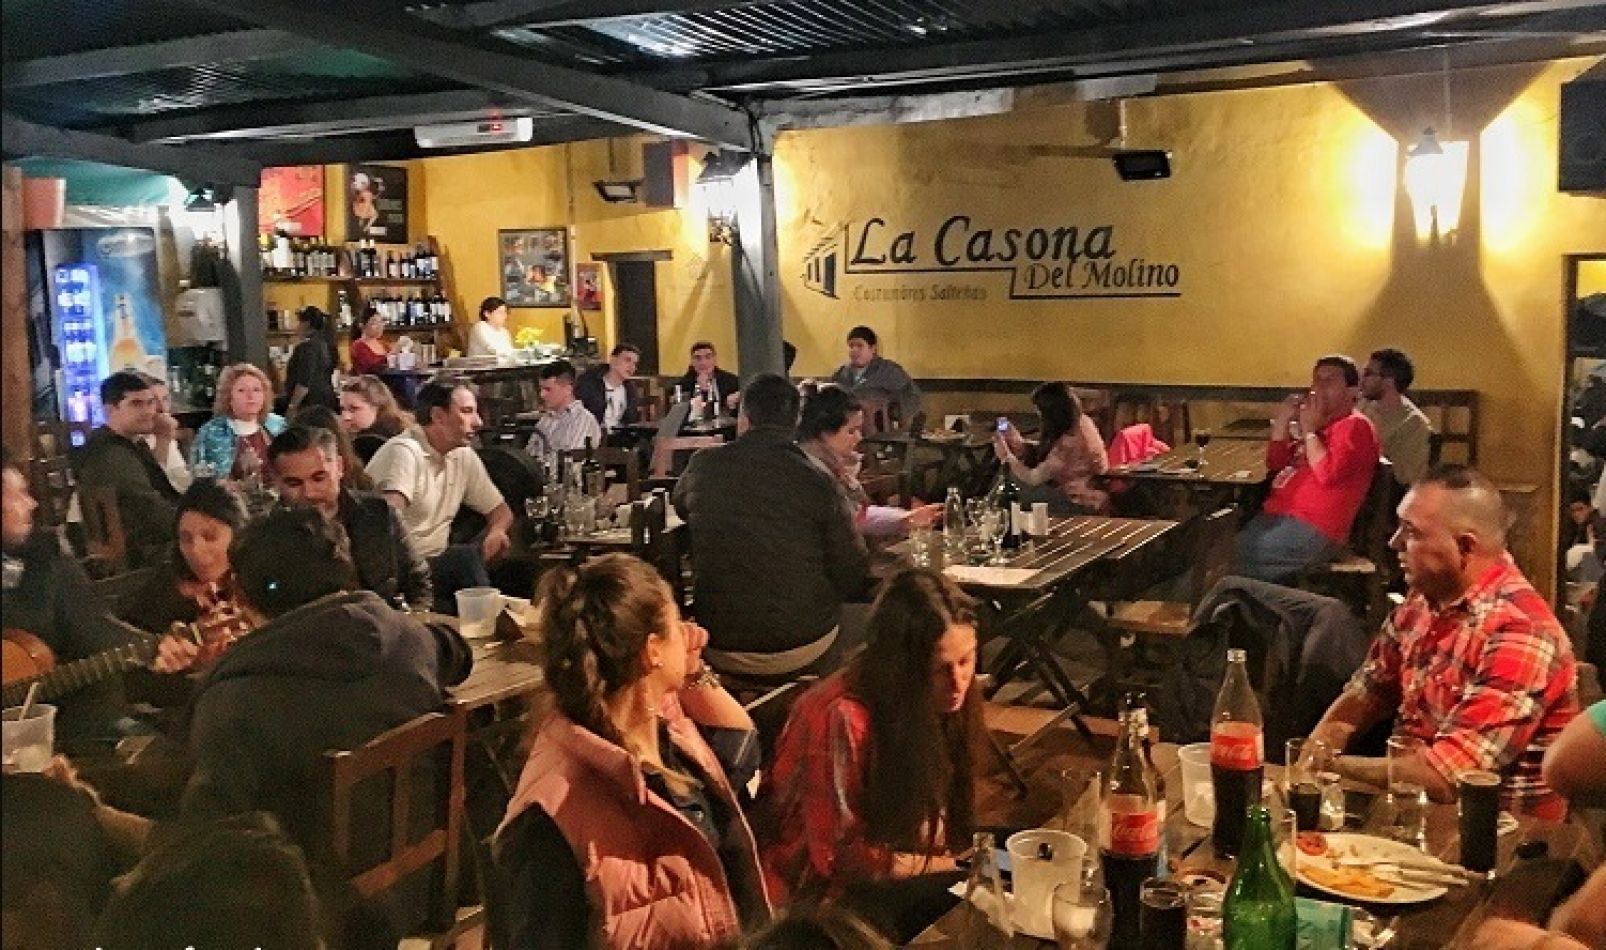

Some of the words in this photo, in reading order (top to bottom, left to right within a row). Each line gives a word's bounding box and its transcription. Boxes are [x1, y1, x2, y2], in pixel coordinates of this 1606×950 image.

[851, 217, 916, 264] La
[935, 215, 1116, 264] Casona
[1024, 259, 1073, 289] Del
[1081, 258, 1179, 289] Molino
